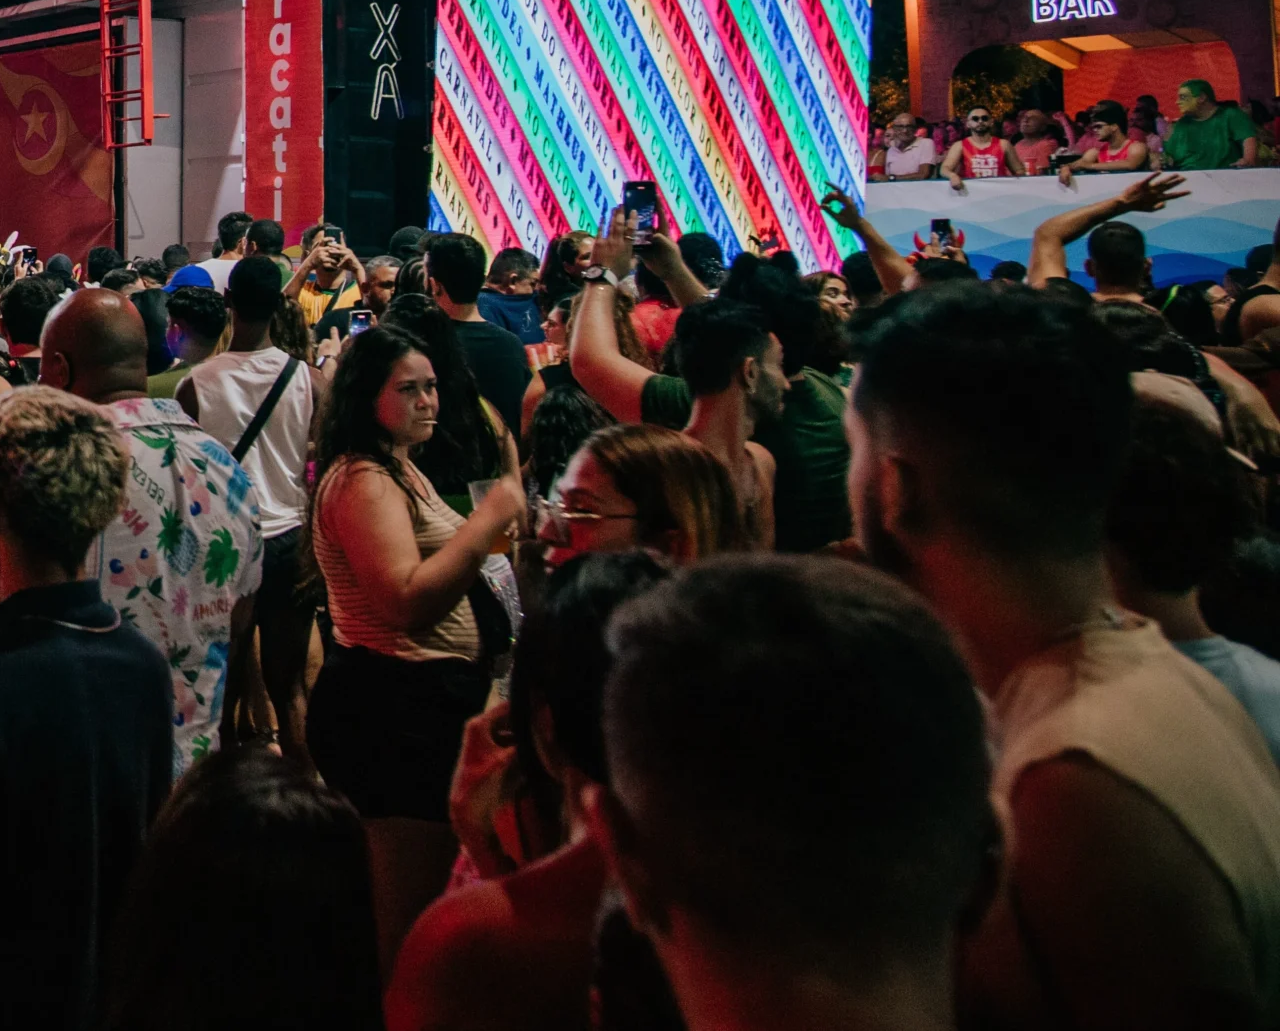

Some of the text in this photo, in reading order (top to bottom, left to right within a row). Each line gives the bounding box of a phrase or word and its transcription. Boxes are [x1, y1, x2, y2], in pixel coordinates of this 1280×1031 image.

[534, 61, 586, 173] MATHEUS
[541, 21, 555, 57] DO
[558, 58, 608, 166] CARNAVAL
[638, 49, 687, 160] MATHEUS
[648, 17, 663, 53] NO
[665, 53, 697, 126] CALOR
[698, 120, 712, 157] DO
[740, 0, 784, 108] CARNAVAL
[793, 117, 806, 150] NO
[795, 64, 836, 168] MATHEUS
[825, 81, 836, 113] NO
[435, 92, 490, 216] RNANDES
[439, 47, 492, 162] CARNAVAL
[508, 183, 523, 220] NO
[517, 139, 566, 236] MATHEU
[524, 100, 540, 137] NO
[542, 136, 576, 212] CALOR
[634, 100, 648, 135] NO
[651, 135, 681, 209] CALOR
[703, 79, 759, 208] FERNANDES
[712, 42, 726, 76] DO
[728, 77, 772, 180] CARNAVAL
[780, 193, 793, 226] NO
[795, 226, 817, 273] CALO
[783, 140, 824, 245] MATHEUS
